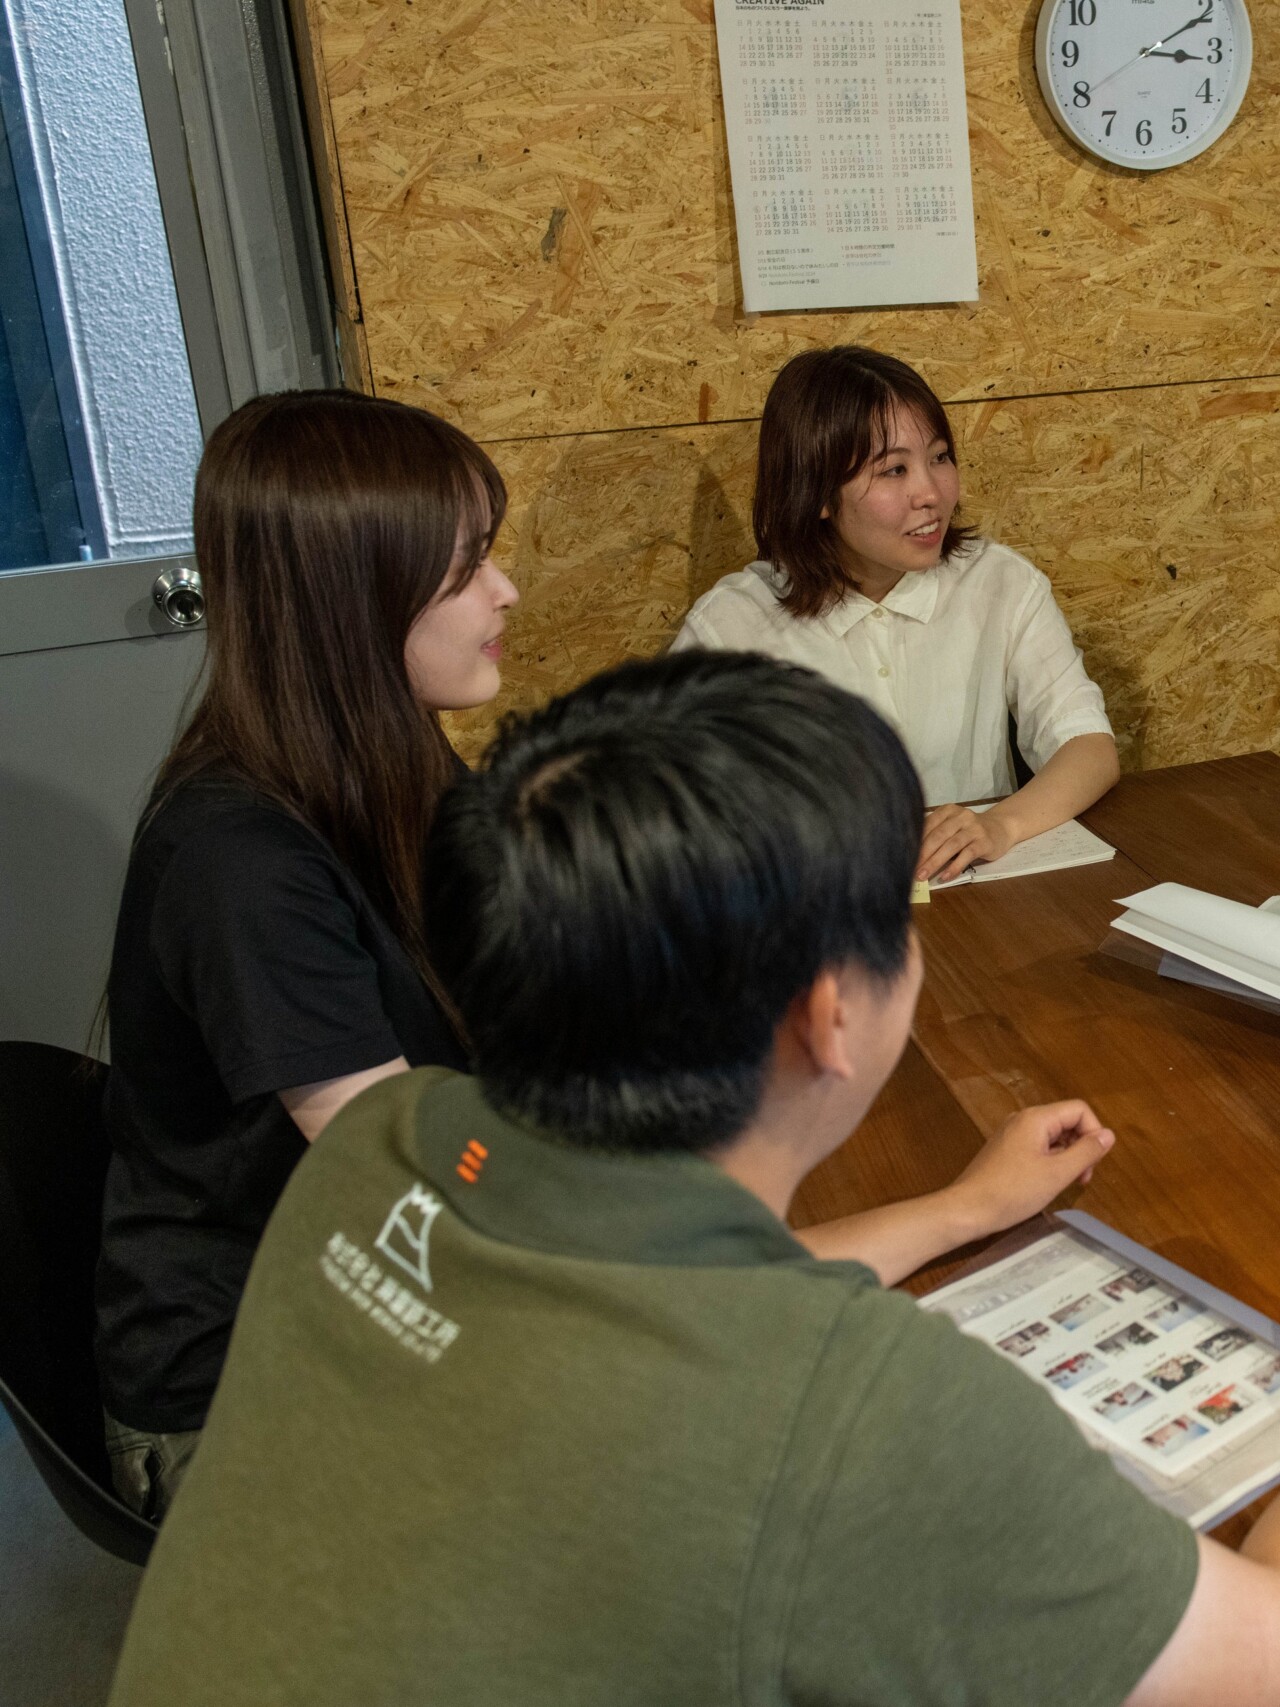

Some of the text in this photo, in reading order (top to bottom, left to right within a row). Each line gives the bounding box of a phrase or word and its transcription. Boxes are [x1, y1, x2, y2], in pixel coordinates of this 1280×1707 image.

[1068, 0, 1097, 26] 10
[1198, 0, 1213, 23] 2
[1061, 40, 1080, 68] 9
[1207, 37, 1223, 64] 3
[1072, 81, 1091, 108] 8
[1195, 77, 1214, 104] 4
[1101, 110, 1117, 137] 7
[1135, 119, 1153, 146] 6
[1171, 108, 1187, 134] 5
